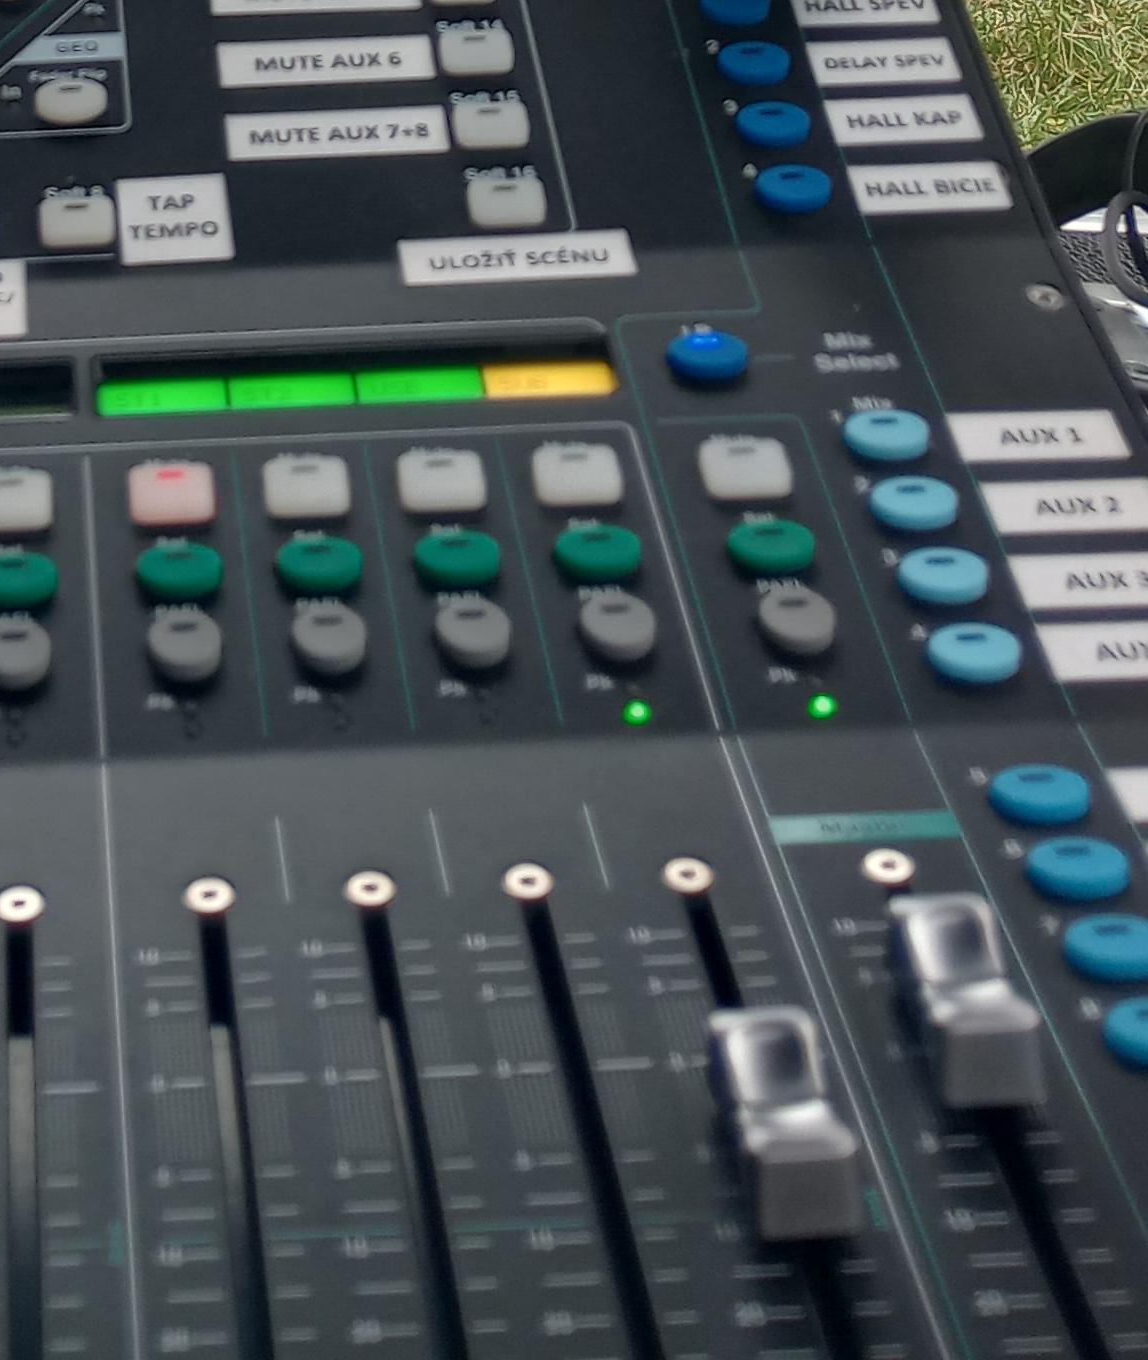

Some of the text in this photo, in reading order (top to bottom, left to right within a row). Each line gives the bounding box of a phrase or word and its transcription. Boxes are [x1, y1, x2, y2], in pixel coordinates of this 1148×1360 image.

[55, 39, 99, 54] GEQ
[253, 50, 403, 72] MUTE AUX 6
[823, 53, 946, 70] DELAY SPEV
[846, 110, 963, 130] HALL KAP
[248, 122, 431, 146] MUTE AUX 7+8
[865, 178, 998, 199] HALL BICIE
[146, 193, 196, 211] TAP
[128, 220, 220, 241] TEMPO
[525, 244, 612, 268] SCÉNU
[822, 331, 873, 351] Mix
[813, 352, 901, 374] Select
[1001, 427, 1084, 445] AUX 1
[1036, 496, 1121, 516] AUX 2
[1065, 572, 1129, 591] AUX
